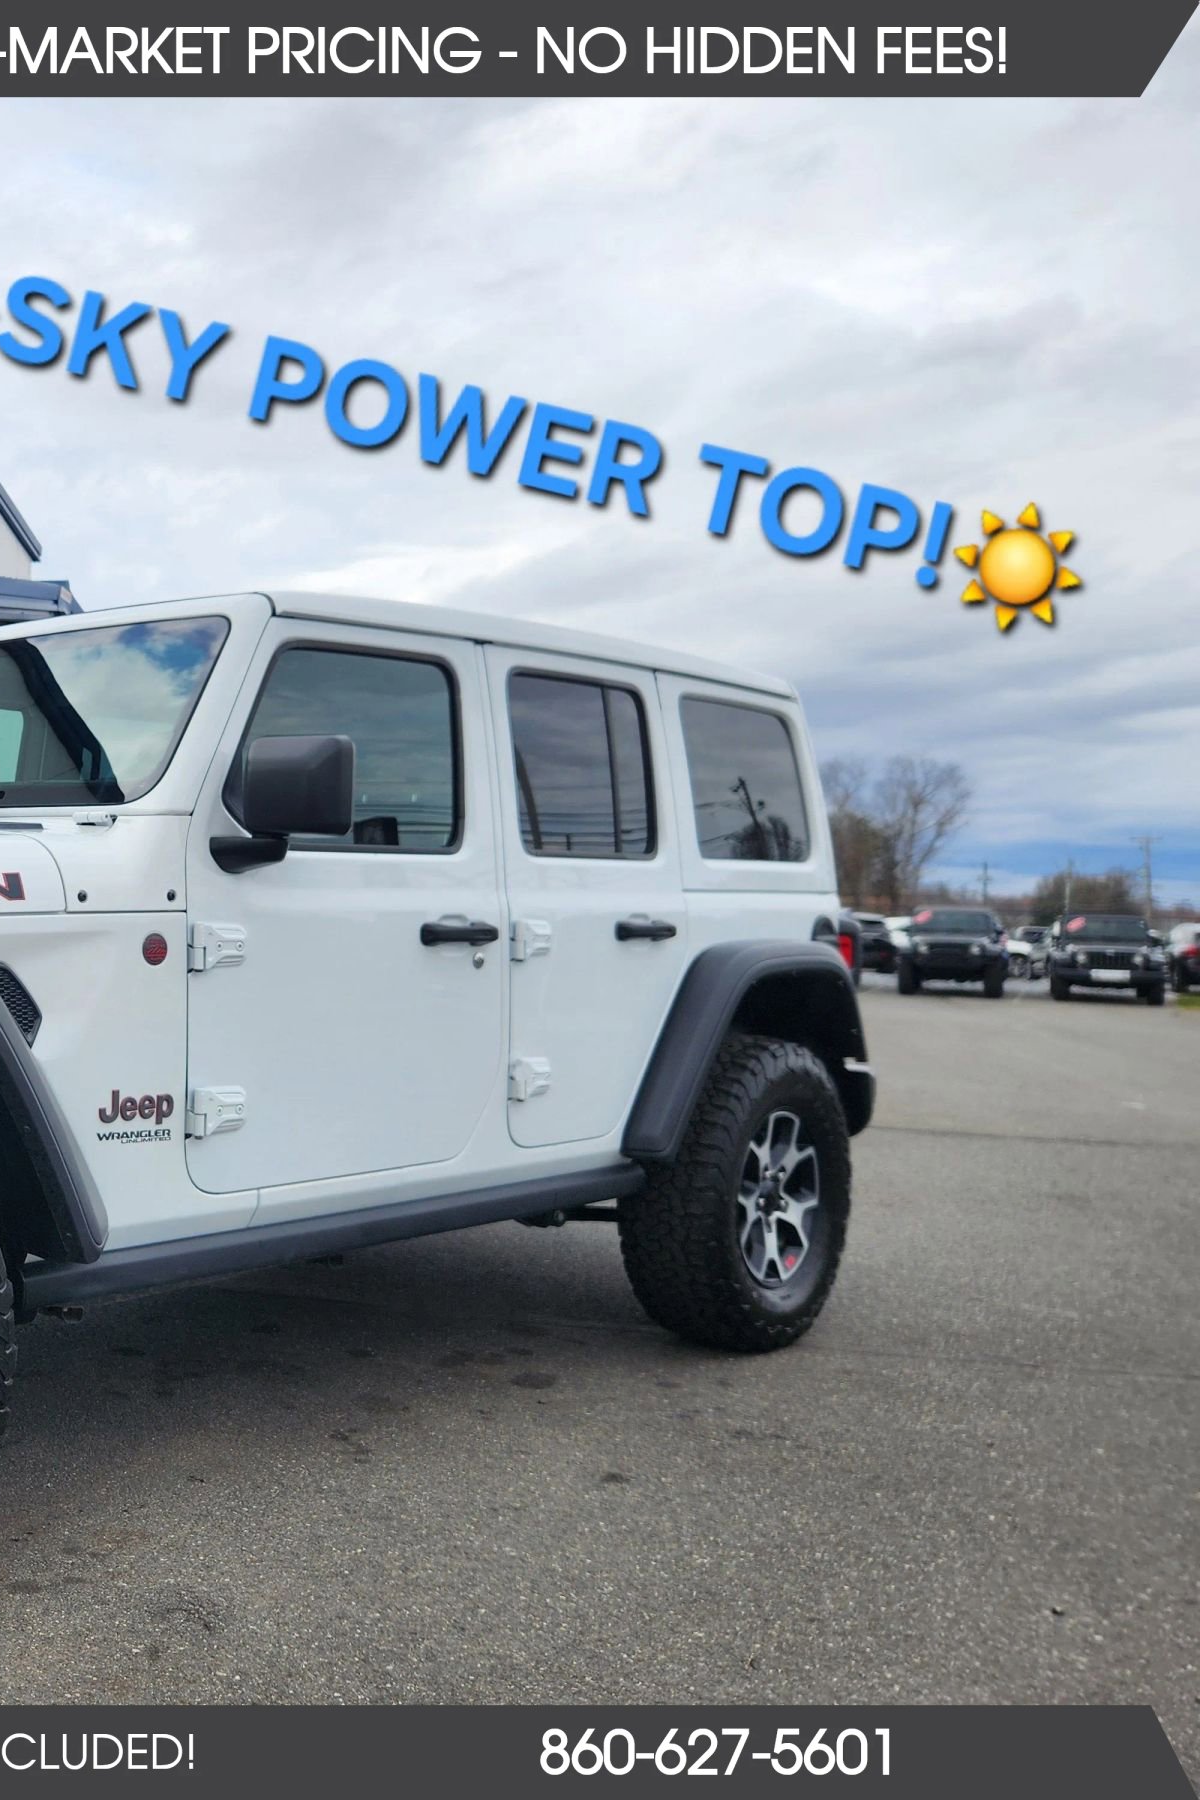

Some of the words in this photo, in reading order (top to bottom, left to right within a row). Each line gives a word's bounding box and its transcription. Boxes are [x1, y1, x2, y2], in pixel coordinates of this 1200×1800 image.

[98, 1089, 175, 1125] Jeep
[96, 1128, 171, 1142] WRANGLER
[120, 1136, 172, 1144] UNLIMITED
